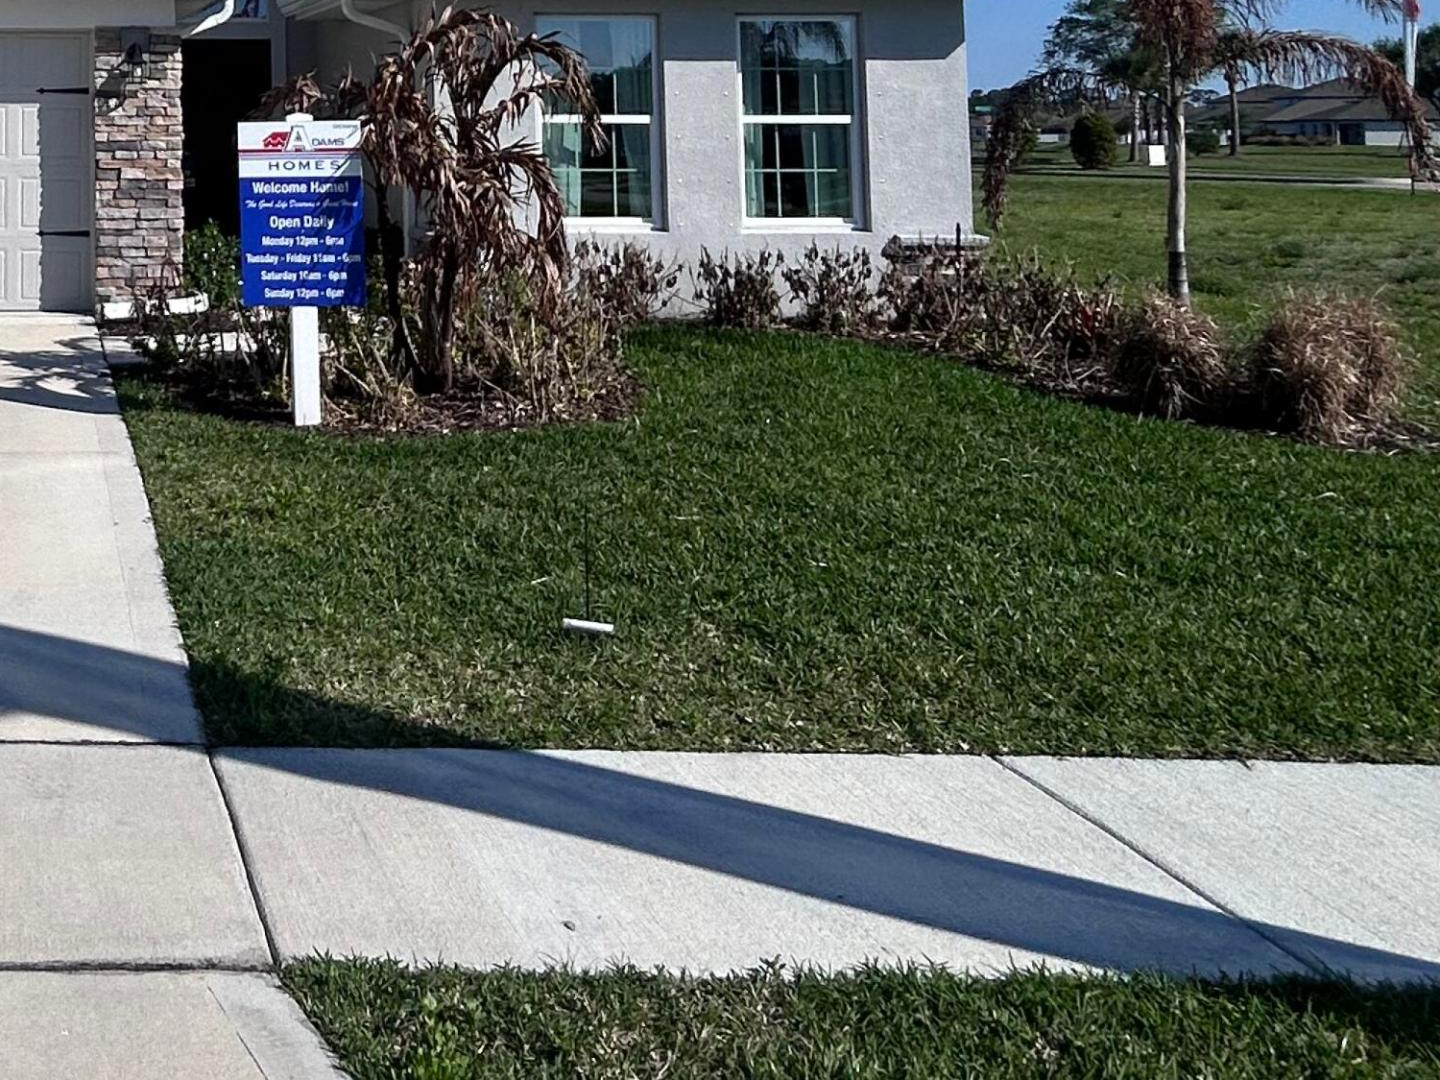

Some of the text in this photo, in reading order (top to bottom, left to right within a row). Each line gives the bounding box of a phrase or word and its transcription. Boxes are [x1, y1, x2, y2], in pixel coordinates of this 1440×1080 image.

[268, 160, 341, 171] HOMES
[252, 180, 349, 194] Welcome Home!
[269, 214, 335, 230] Open Daily
[261, 235, 295, 247] Monday
[296, 235, 319, 247] 12pm
[245, 253, 279, 265] Tuesday
[285, 253, 312, 264] Friday
[260, 270, 297, 282] Saturday
[264, 287, 295, 300] Sunday
[296, 287, 319, 299] 12pm
